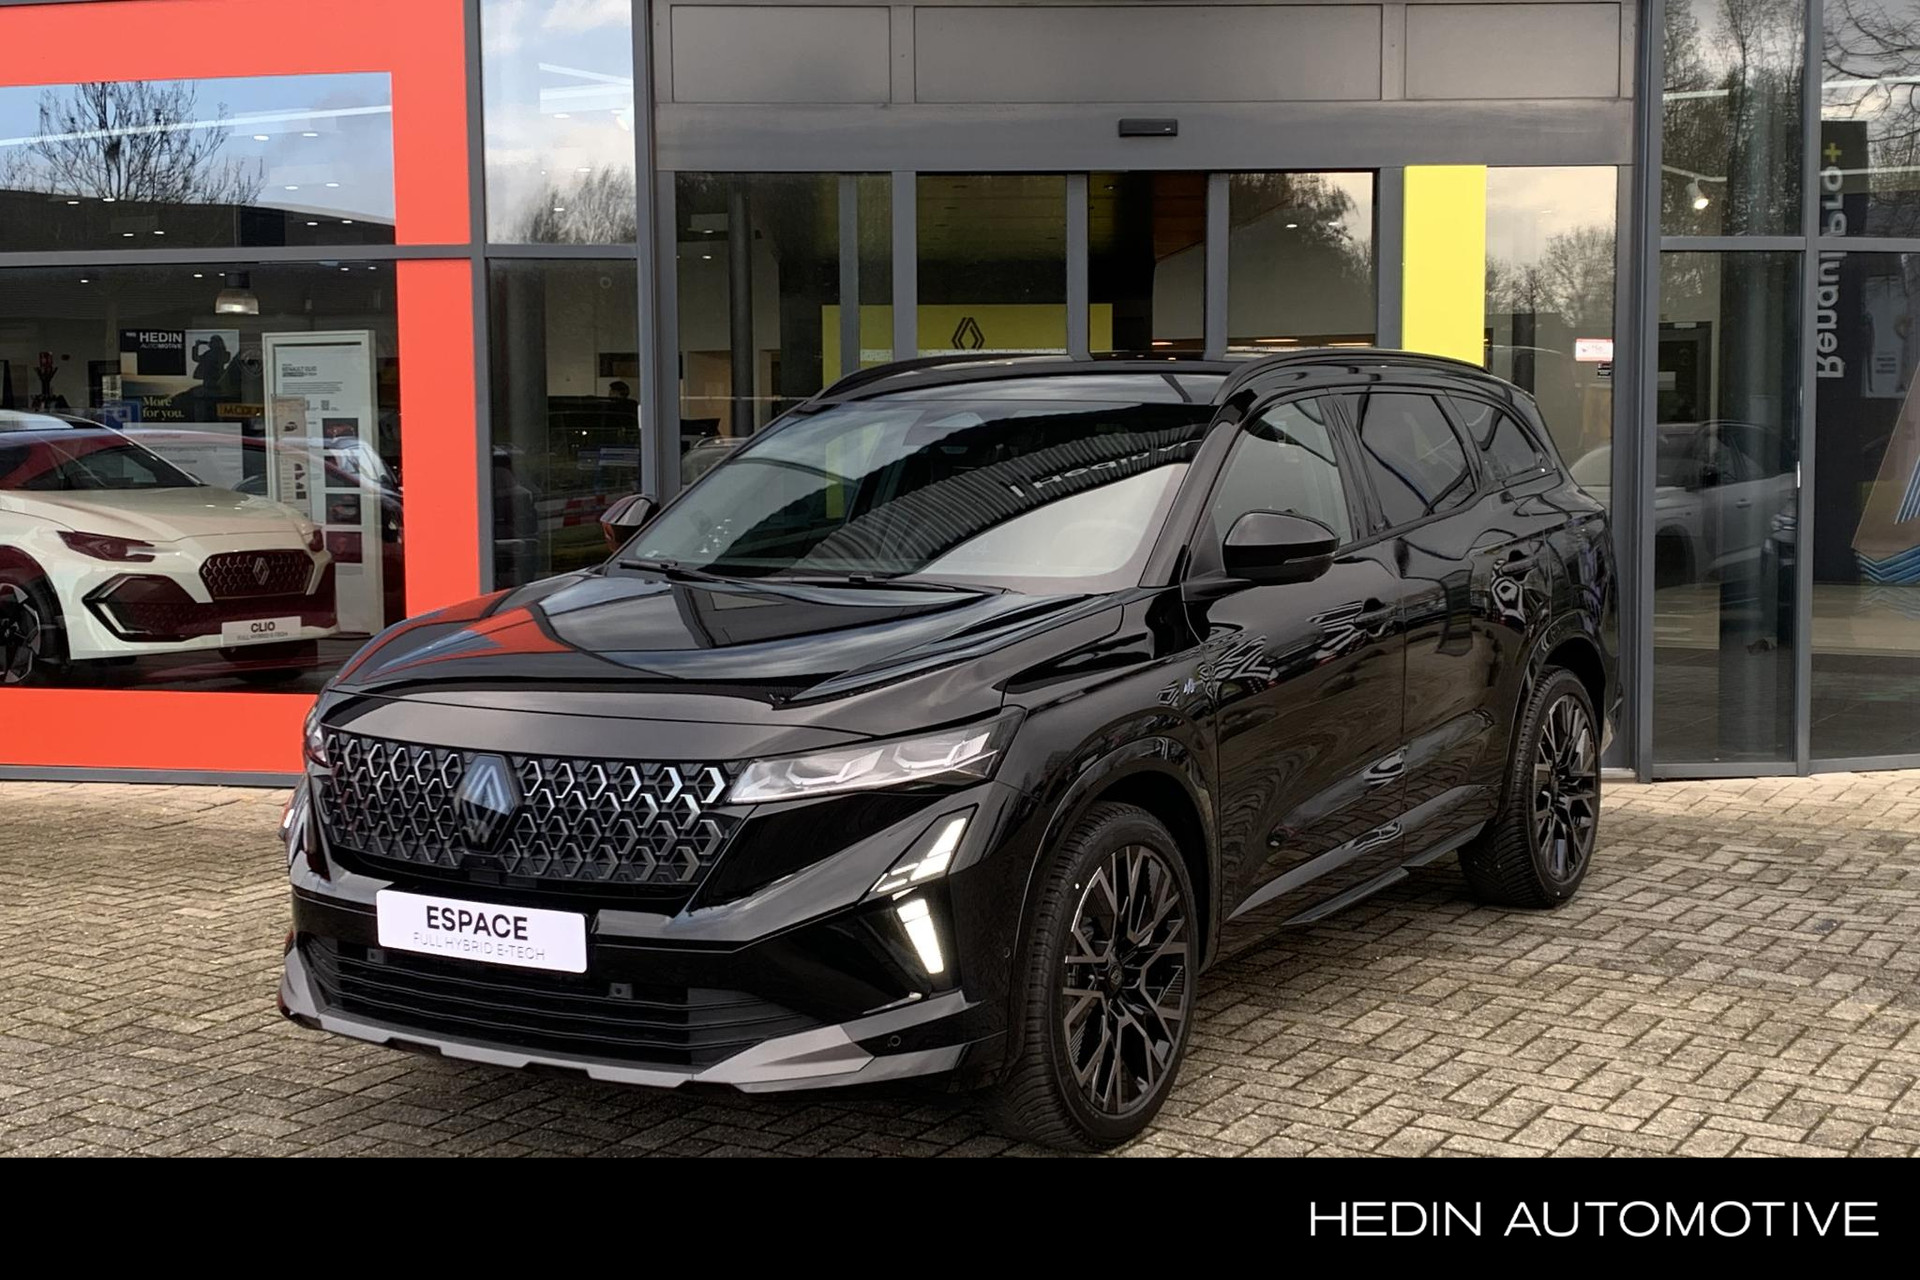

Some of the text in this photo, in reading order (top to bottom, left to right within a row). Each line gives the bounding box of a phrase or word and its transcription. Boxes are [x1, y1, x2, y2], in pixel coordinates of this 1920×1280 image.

[139, 331, 183, 343] HEDIN
[142, 395, 173, 408] More
[142, 408, 185, 421] for you.
[251, 621, 276, 633] CLIO
[426, 905, 528, 941] ESPACE
[413, 931, 545, 961] FULL HYBRID E-TECH
